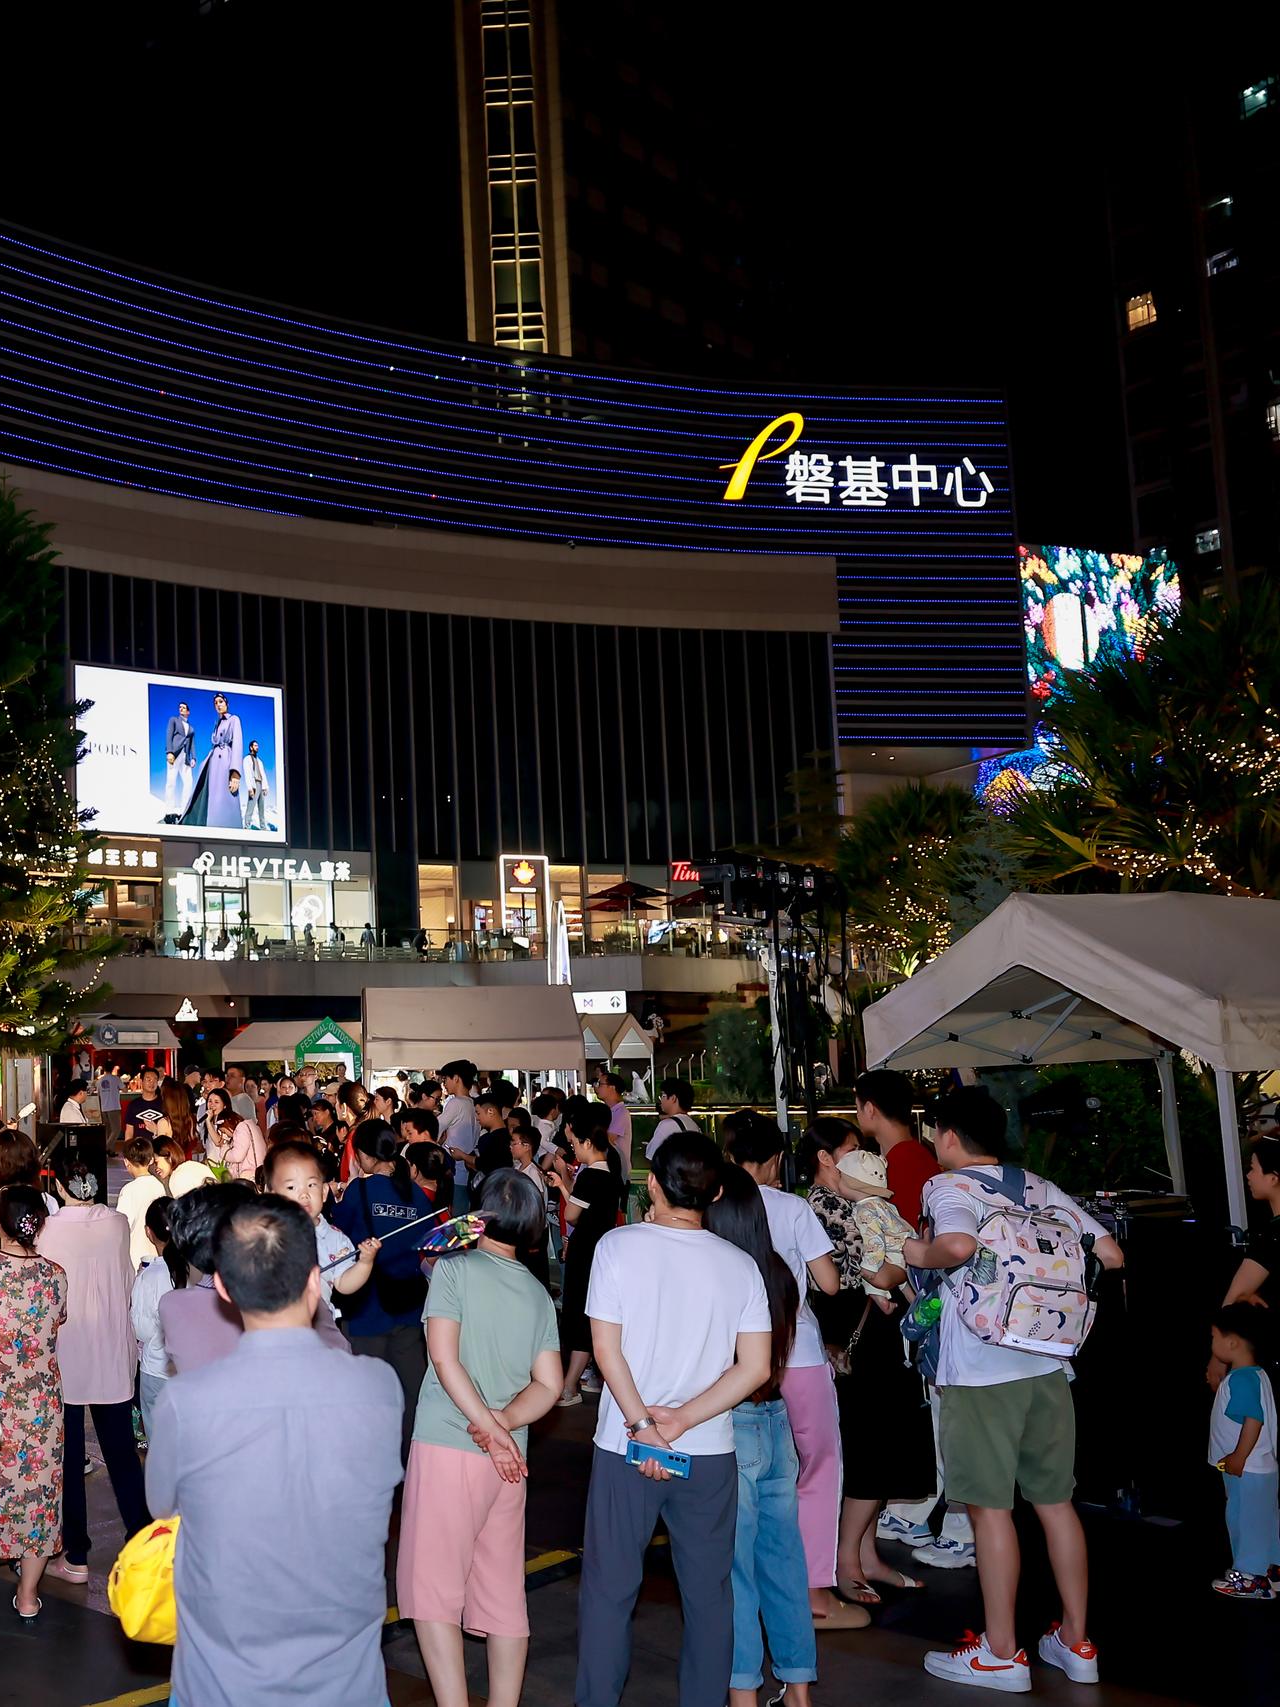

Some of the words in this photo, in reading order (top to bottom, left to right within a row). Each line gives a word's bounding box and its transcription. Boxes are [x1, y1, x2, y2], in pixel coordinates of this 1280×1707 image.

[784, 450, 995, 507] 磐基中心
[221, 856, 313, 881] HEYTEA
[319, 860, 351, 881] 喜茶
[300, 1023, 328, 1052] FESTIVAL
[328, 1022, 356, 1051] OUTDOOR
